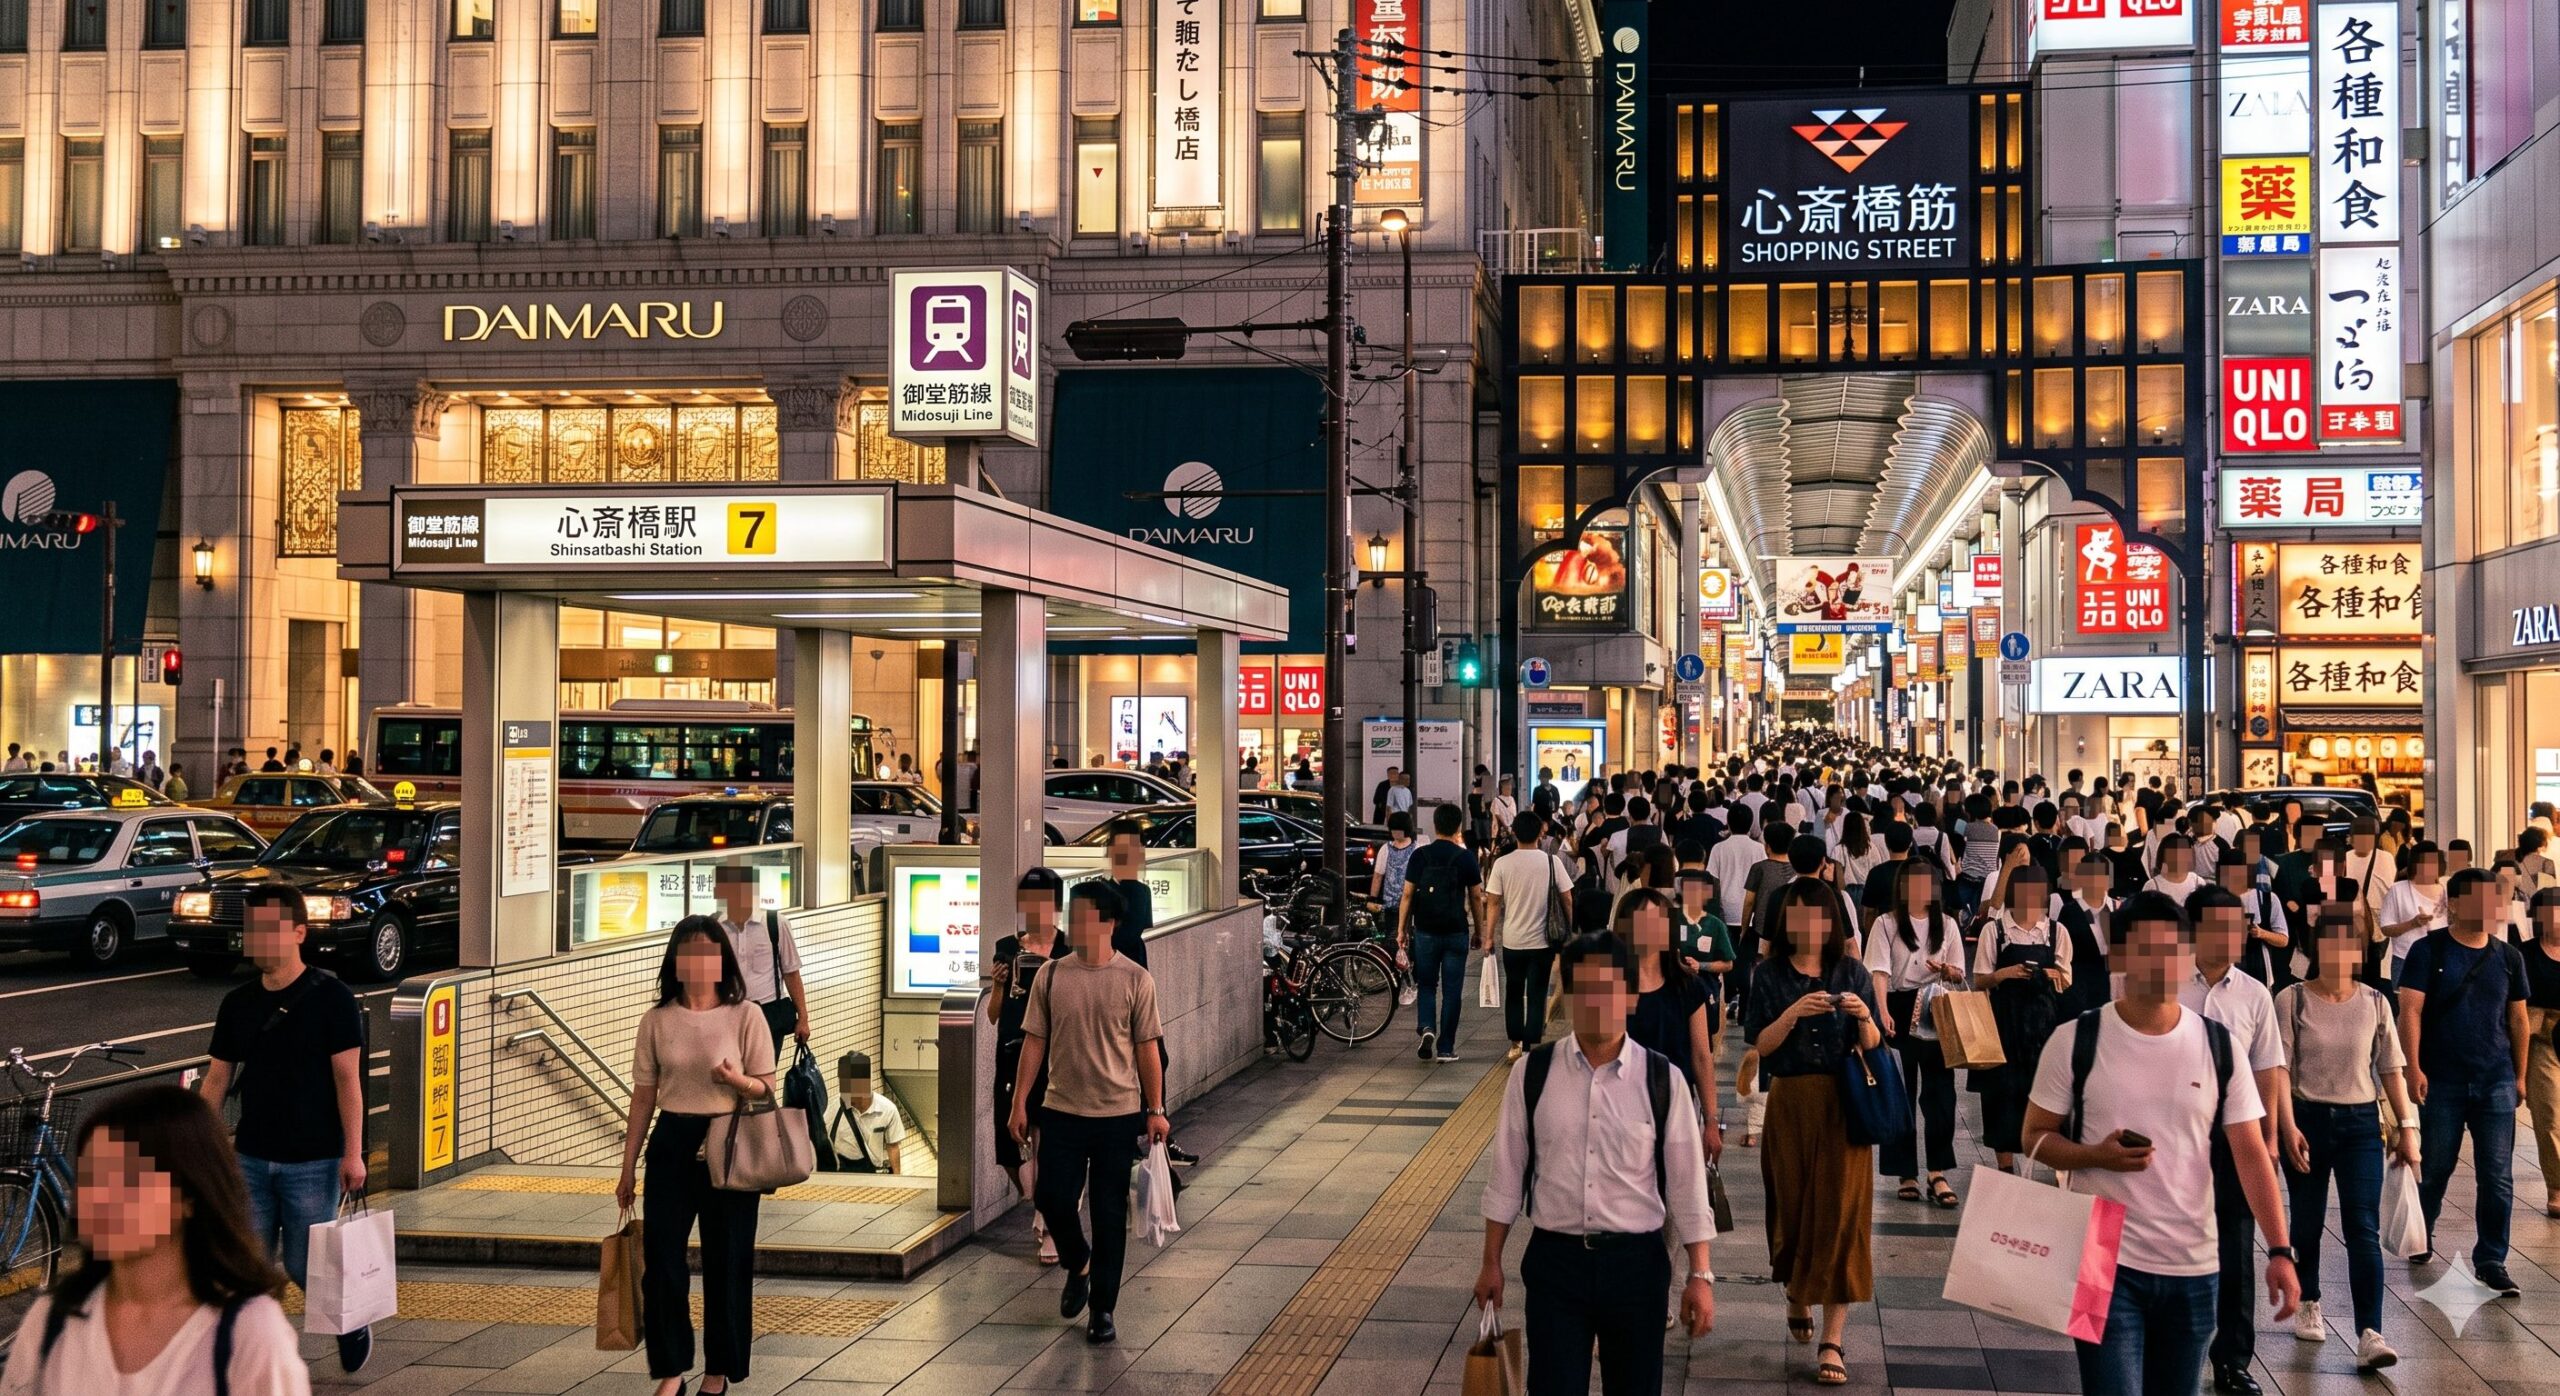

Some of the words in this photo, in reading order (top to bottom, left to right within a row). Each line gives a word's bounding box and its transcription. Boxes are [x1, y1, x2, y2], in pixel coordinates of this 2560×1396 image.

[1616, 63, 1636, 190] DAIMARU
[2332, 17, 2386, 230] 各種和食
[2240, 165, 2296, 220] 薬
[1741, 182, 1957, 235] 心斎橋筋
[1741, 241, 1860, 263] SHOPPING
[1867, 238, 1957, 259] STREET
[2227, 295, 2310, 316] ZARA
[444, 301, 723, 341] DAIMARU
[903, 382, 992, 405] 御堂筋線
[2233, 368, 2300, 401] UNI
[902, 410, 959, 423] Midosuji
[964, 409, 993, 420] Line
[2233, 407, 2307, 447] QLO
[2239, 477, 2344, 519] 薬局
[408, 515, 479, 535] 御堂筋線
[557, 506, 696, 539] 心斎橋駅
[739, 511, 766, 548] 7
[1129, 527, 1254, 544] DAIMARU
[650, 543, 702, 556] Station
[2320, 553, 2410, 575] 各種和食
[2083, 591, 2116, 607] ユニ
[2126, 589, 2160, 606] UNI
[2082, 610, 2116, 626] クロ
[2126, 608, 2163, 629] QLO
[2512, 603, 2560, 646] ZARA
[1285, 673, 1317, 690] UNI
[2063, 671, 2178, 699] ZARA
[2286, 661, 2423, 693] 各種和食
[1285, 692, 1321, 712] QLO
